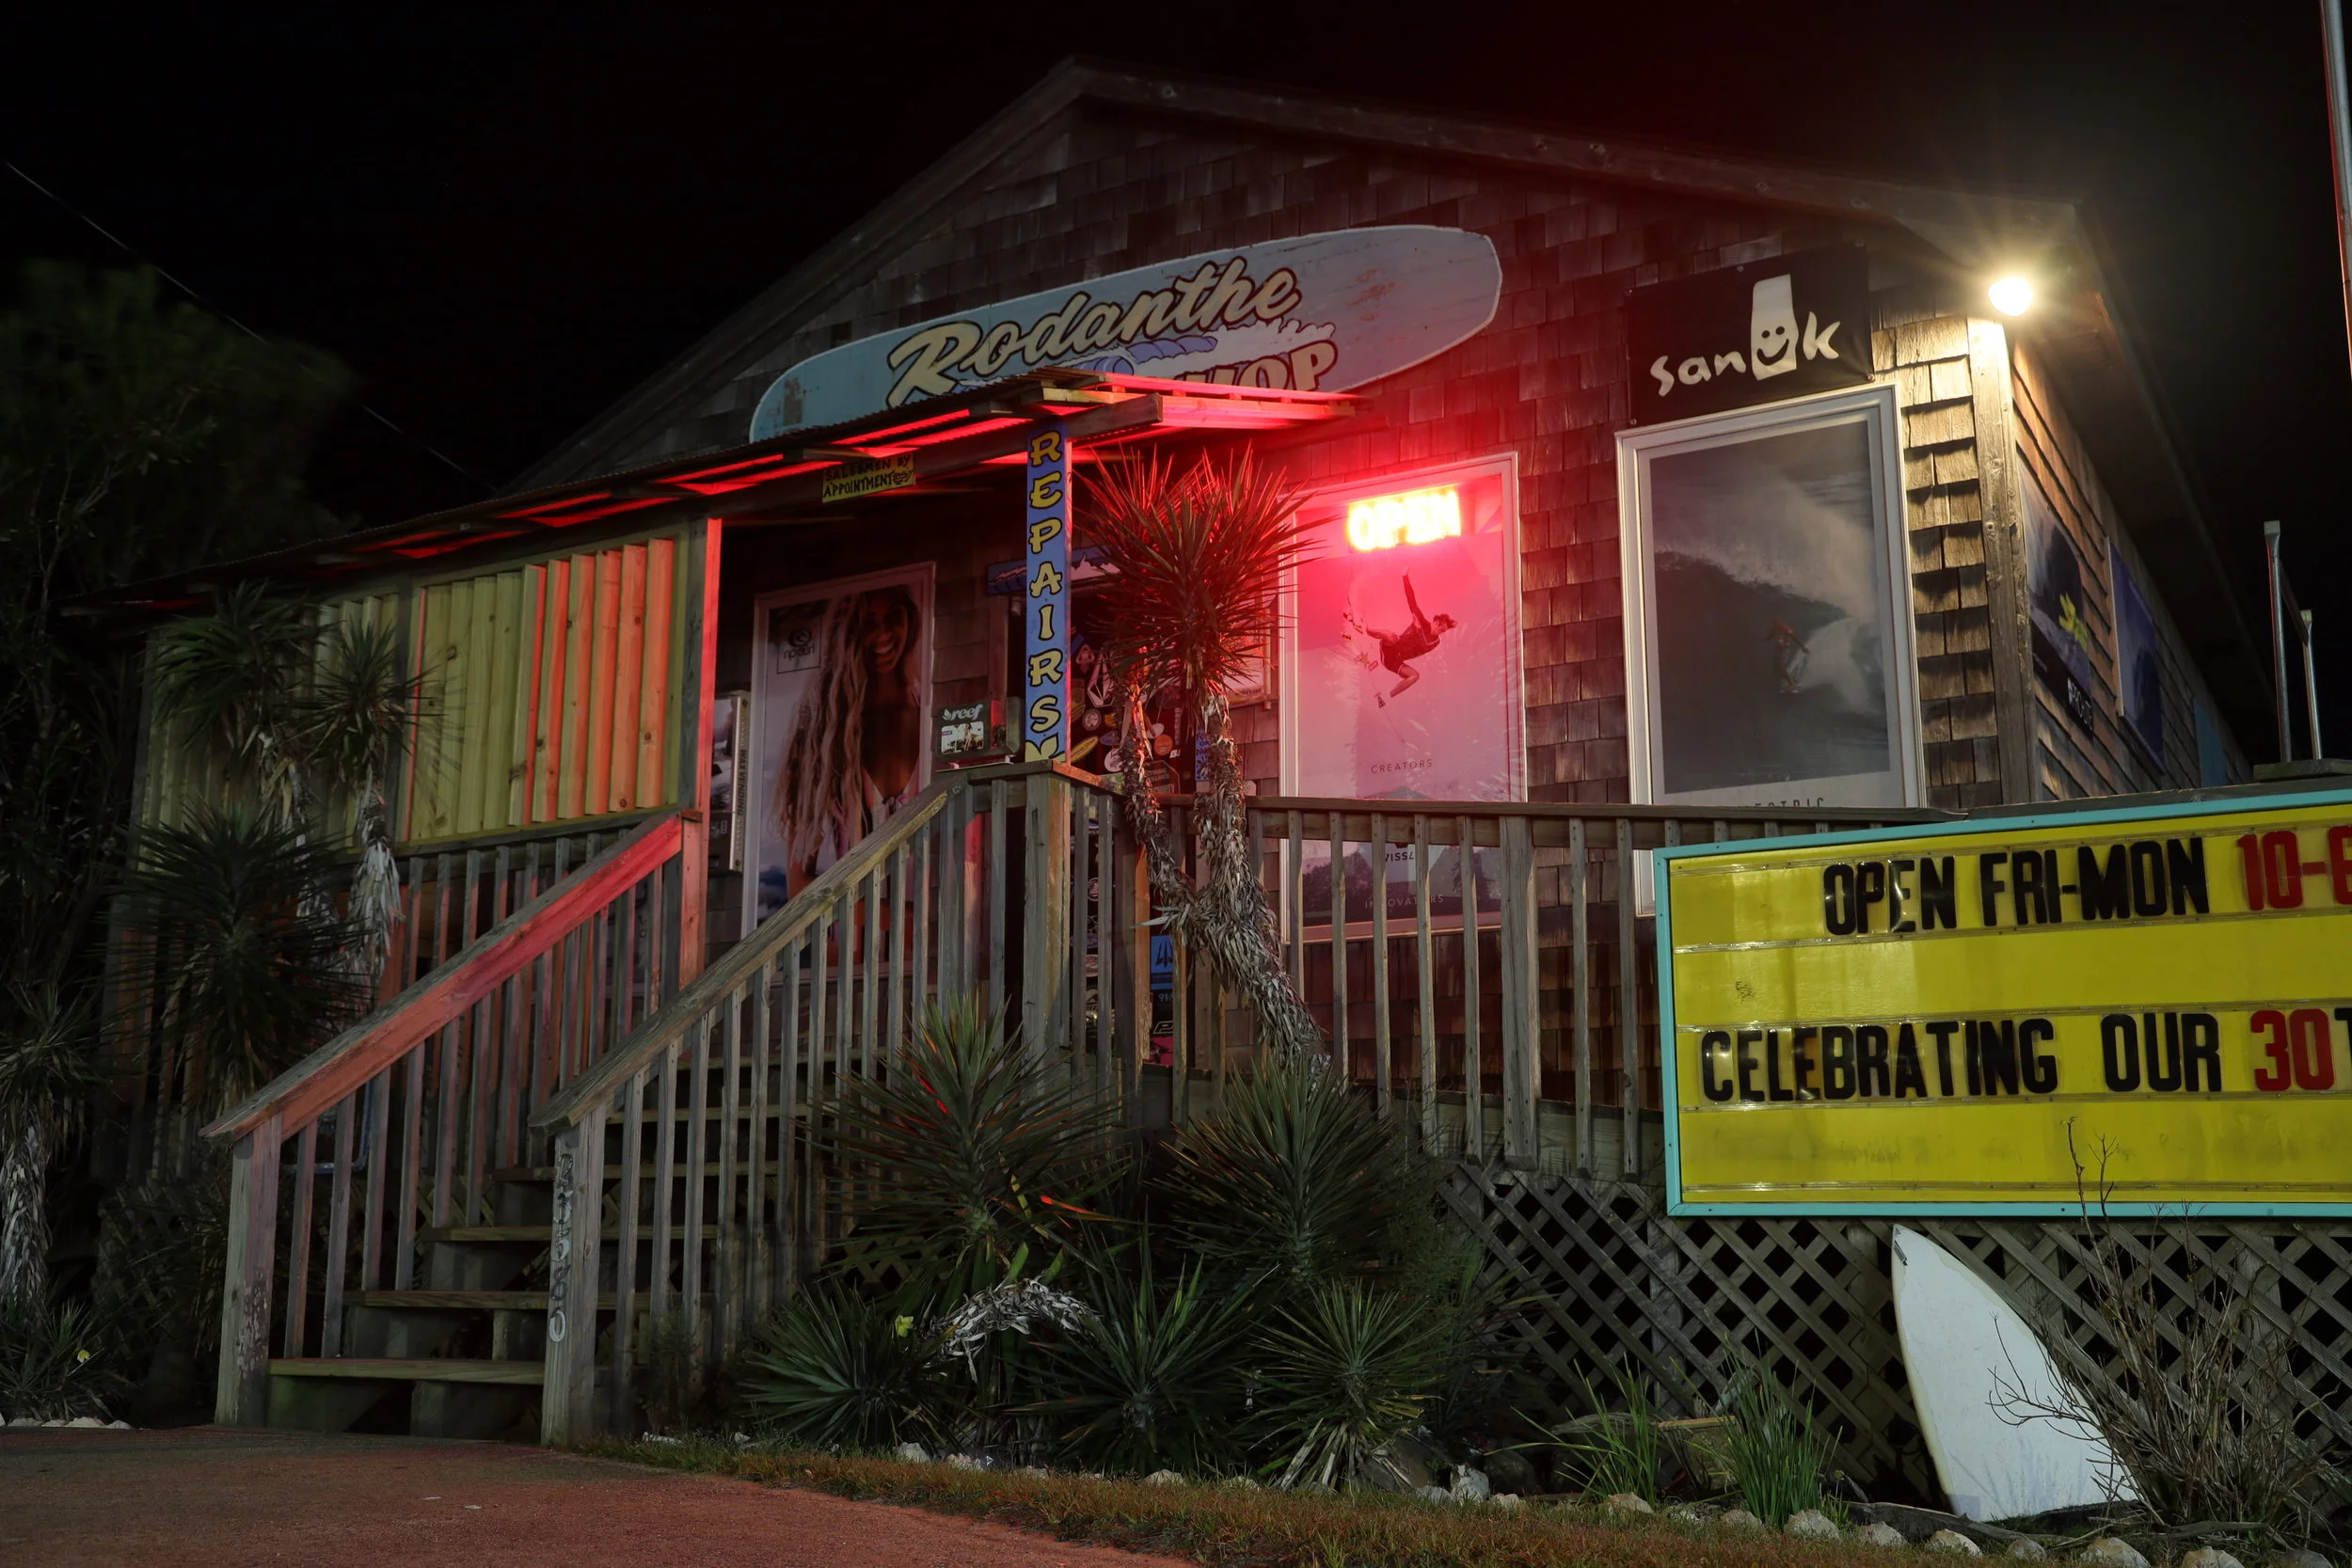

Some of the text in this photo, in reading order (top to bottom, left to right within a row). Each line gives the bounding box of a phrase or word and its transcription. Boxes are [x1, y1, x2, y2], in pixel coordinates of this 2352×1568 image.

[885, 255, 1302, 410] Rodanthe
[1174, 340, 1339, 391] OP
[823, 471, 894, 499] APPOINTMENT
[1348, 488, 1461, 551] OPEN
[1027, 429, 1063, 734] REPAIRS
[949, 704, 984, 721] reef
[737, 771, 746, 816] VENDING
[1371, 758, 1433, 774] CREATORS
[1823, 855, 1958, 936] OPEN
[1979, 837, 2211, 927] FRI-MON
[1701, 1018, 2059, 1103] CELEBRATING
[2100, 1012, 2223, 1093] OUR
